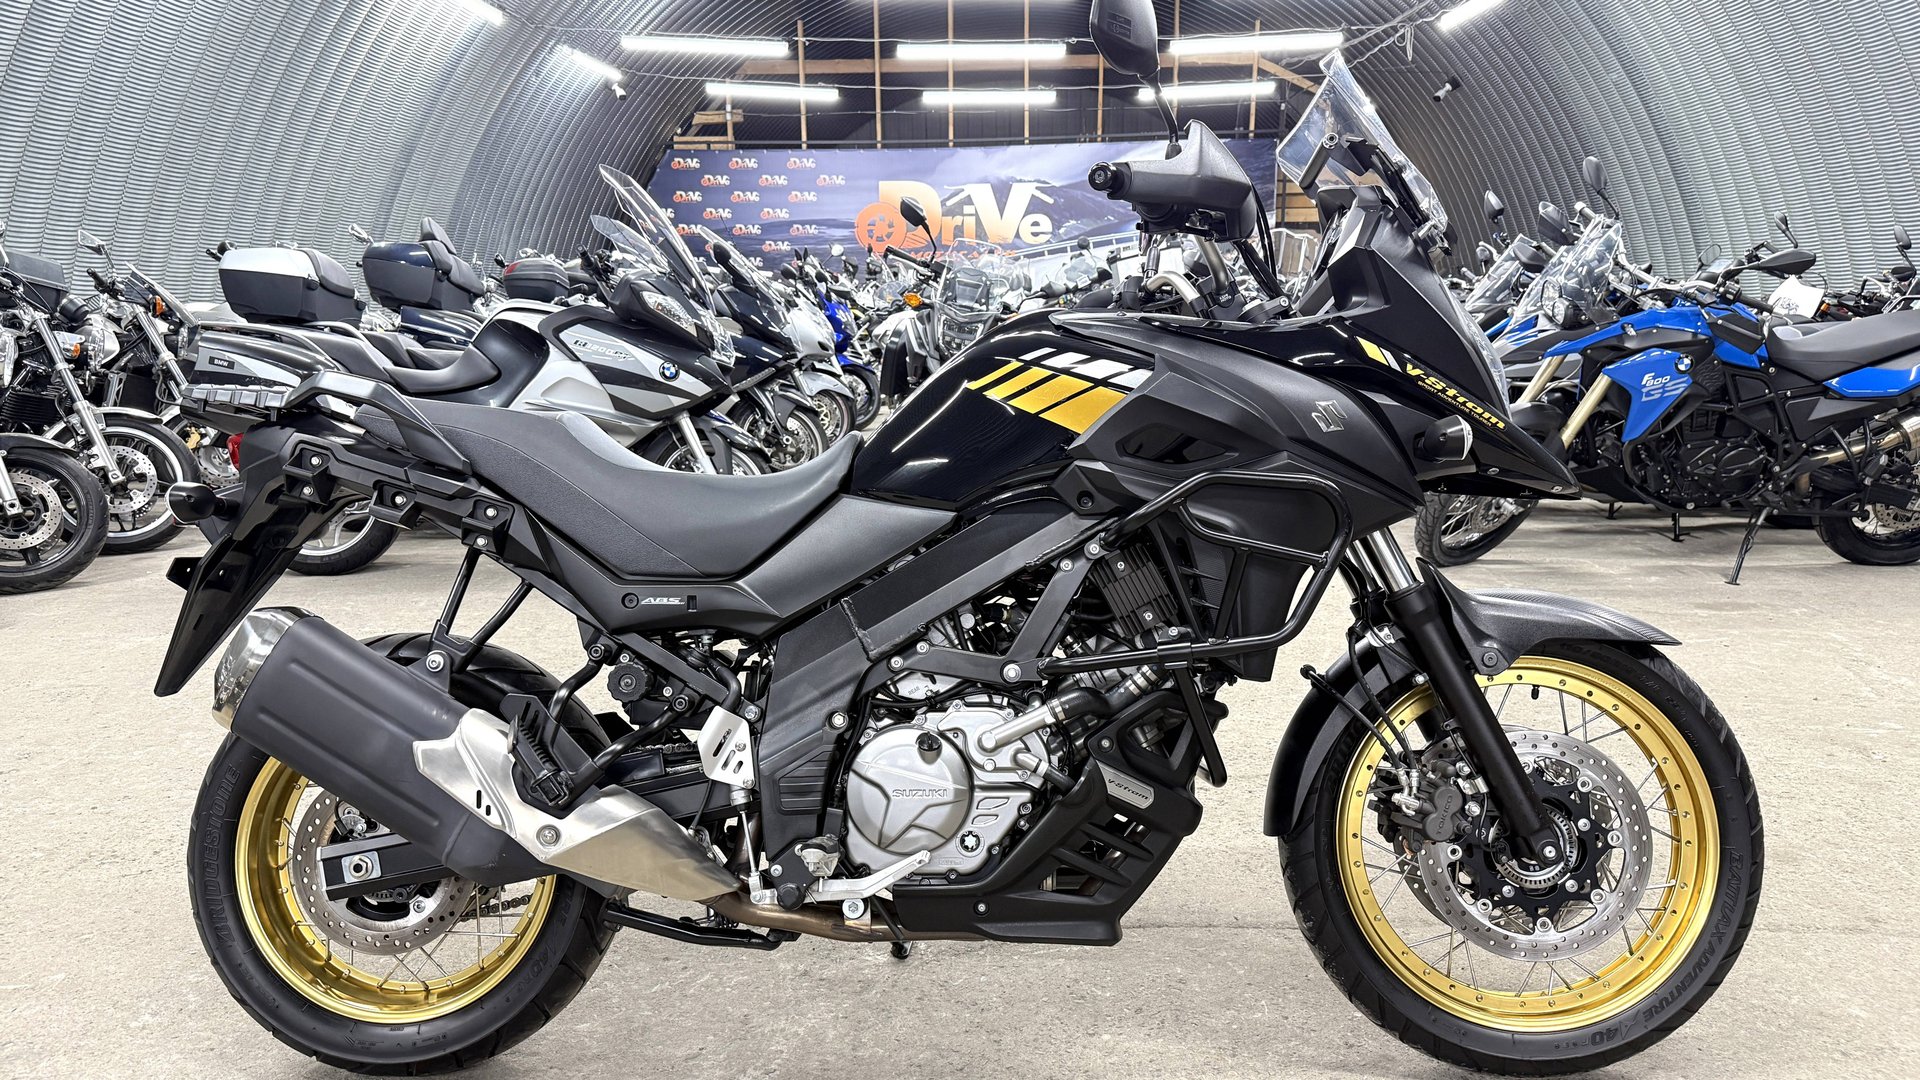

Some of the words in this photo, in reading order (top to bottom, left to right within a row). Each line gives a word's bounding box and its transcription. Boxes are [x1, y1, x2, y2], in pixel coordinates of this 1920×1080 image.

[213, 358, 229, 367] BMW
[1417, 380, 1438, 394] SPORT
[1437, 392, 1470, 414] ADVENTURE
[1471, 411, 1493, 427] TOURER
[641, 597, 684, 605] ABS
[892, 788, 948, 798] SUZUKI
[1436, 793, 1453, 835] TOKICO
